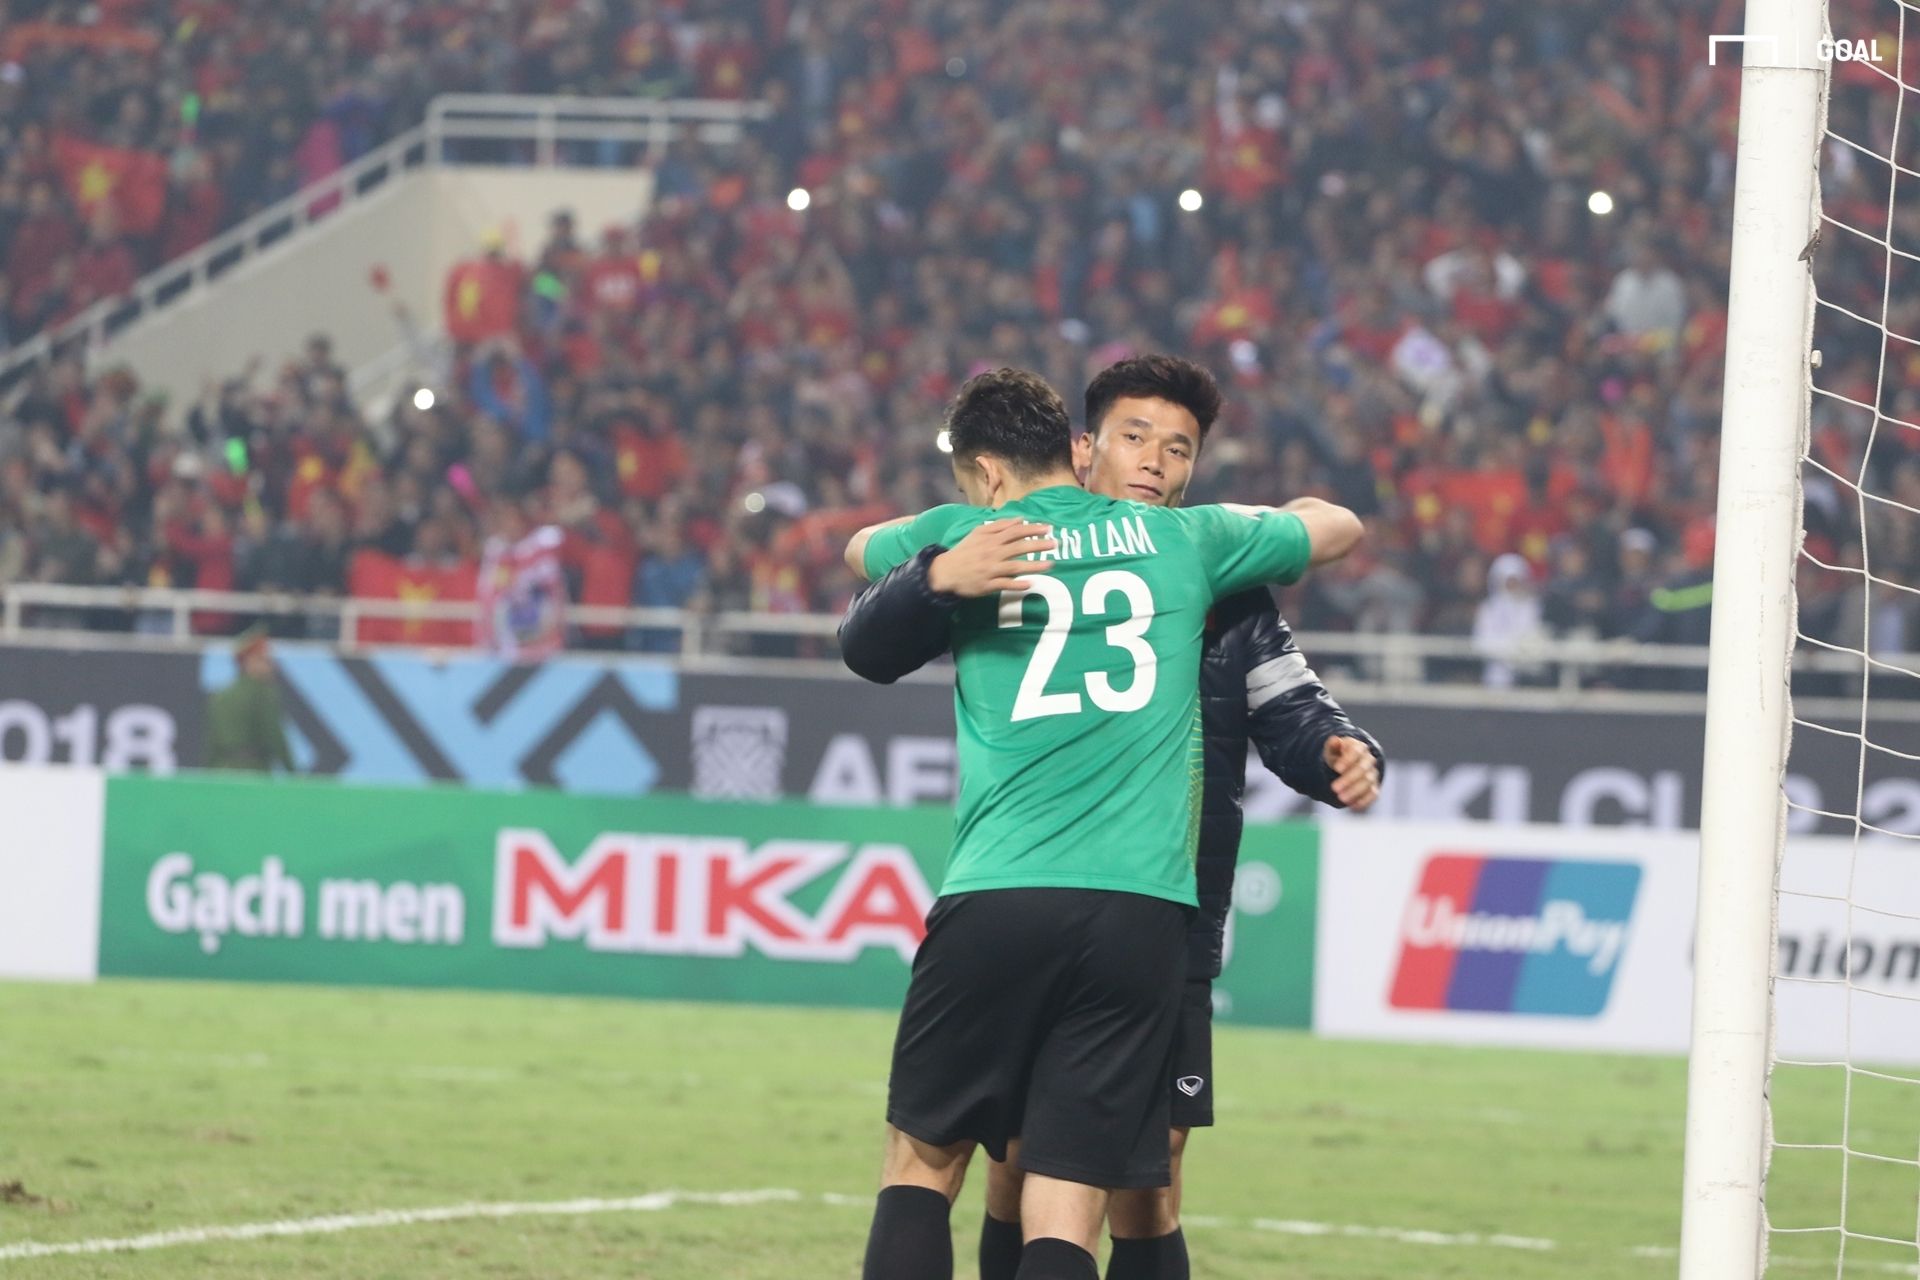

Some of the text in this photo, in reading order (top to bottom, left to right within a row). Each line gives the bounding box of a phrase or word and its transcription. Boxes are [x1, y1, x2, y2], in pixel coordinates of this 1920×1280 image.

[1087, 515, 1158, 557] LAM
[997, 569, 1158, 723] 23
[0, 699, 177, 774] 018
[808, 733, 958, 803] AF
[146, 827, 936, 964] Gạch men MIKA
[1402, 892, 1627, 976] UnionPay
